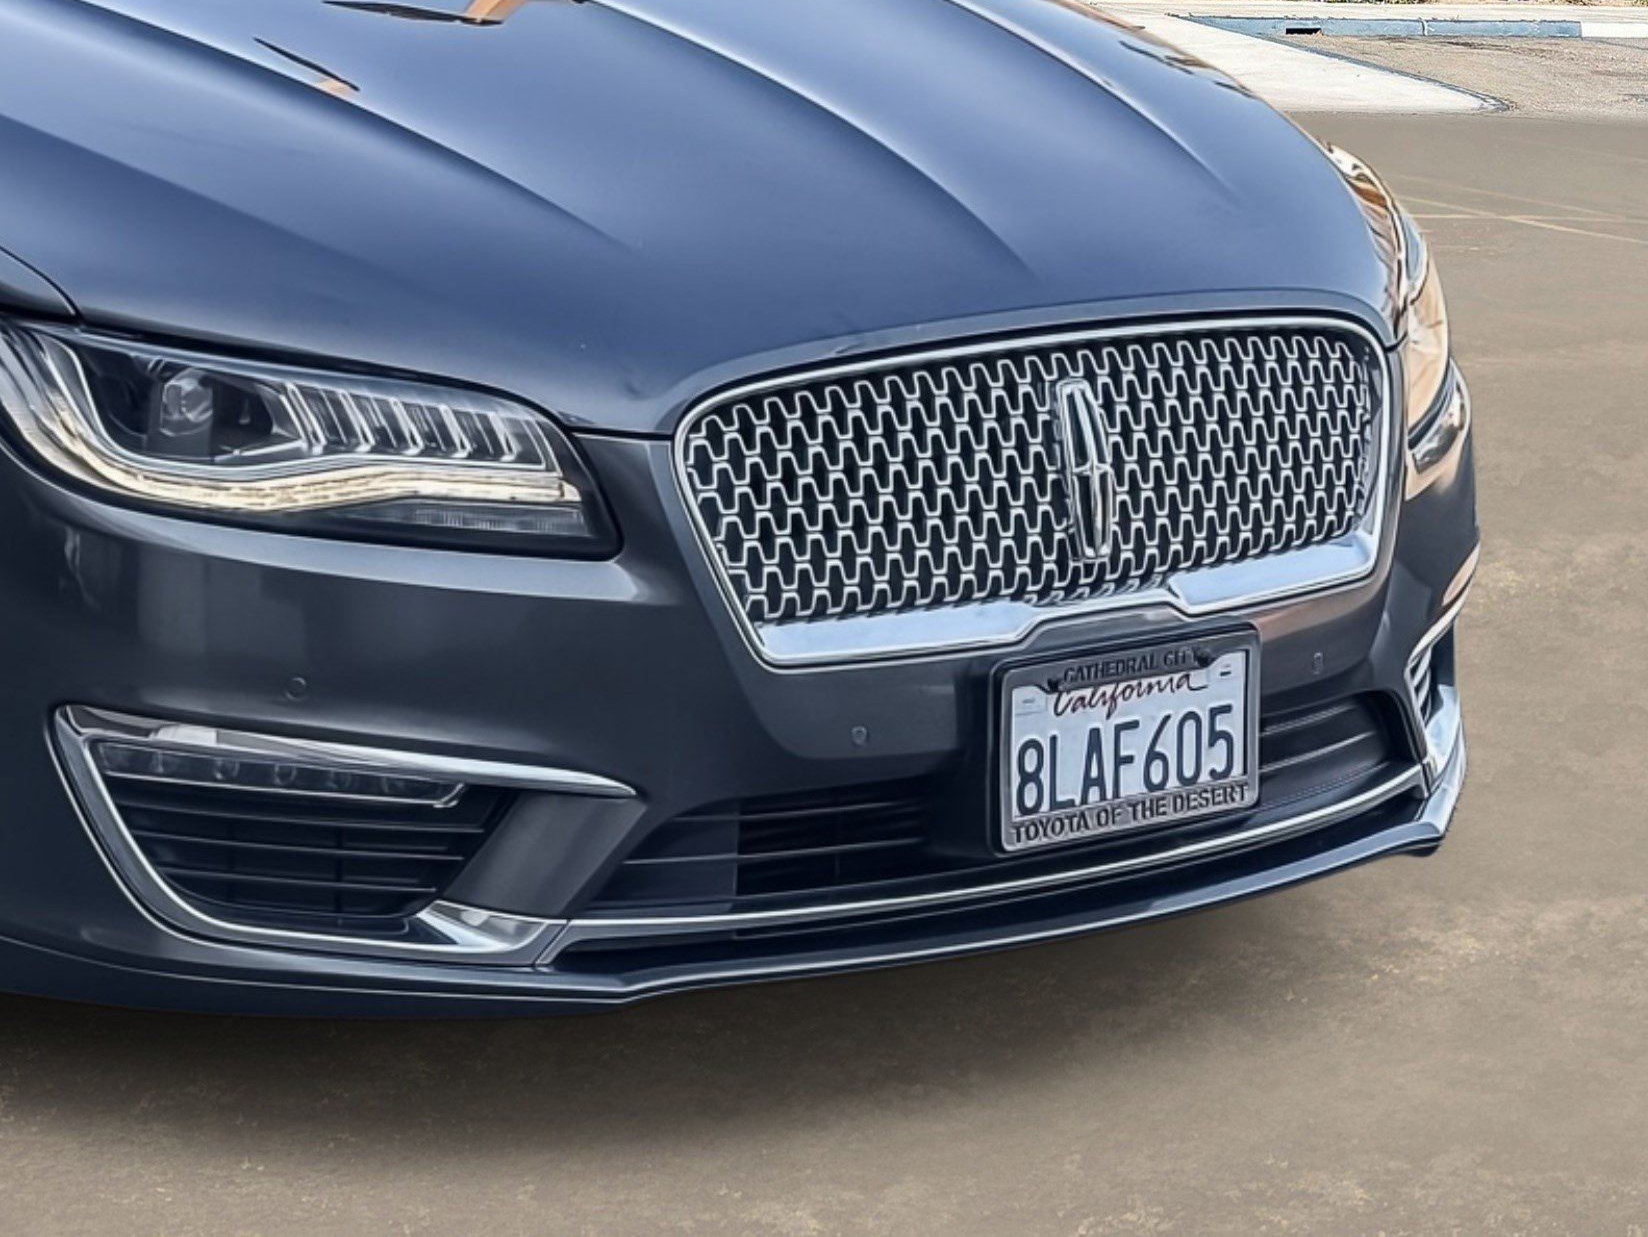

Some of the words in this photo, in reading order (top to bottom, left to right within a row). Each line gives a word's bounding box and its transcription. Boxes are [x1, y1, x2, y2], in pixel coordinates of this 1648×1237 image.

[1016, 703, 1234, 817] 8LAF605
[1013, 811, 1091, 844] TOYOTA
[1096, 805, 1123, 827] OF
[1126, 797, 1168, 822] THE
[1172, 783, 1250, 813] DESERT
